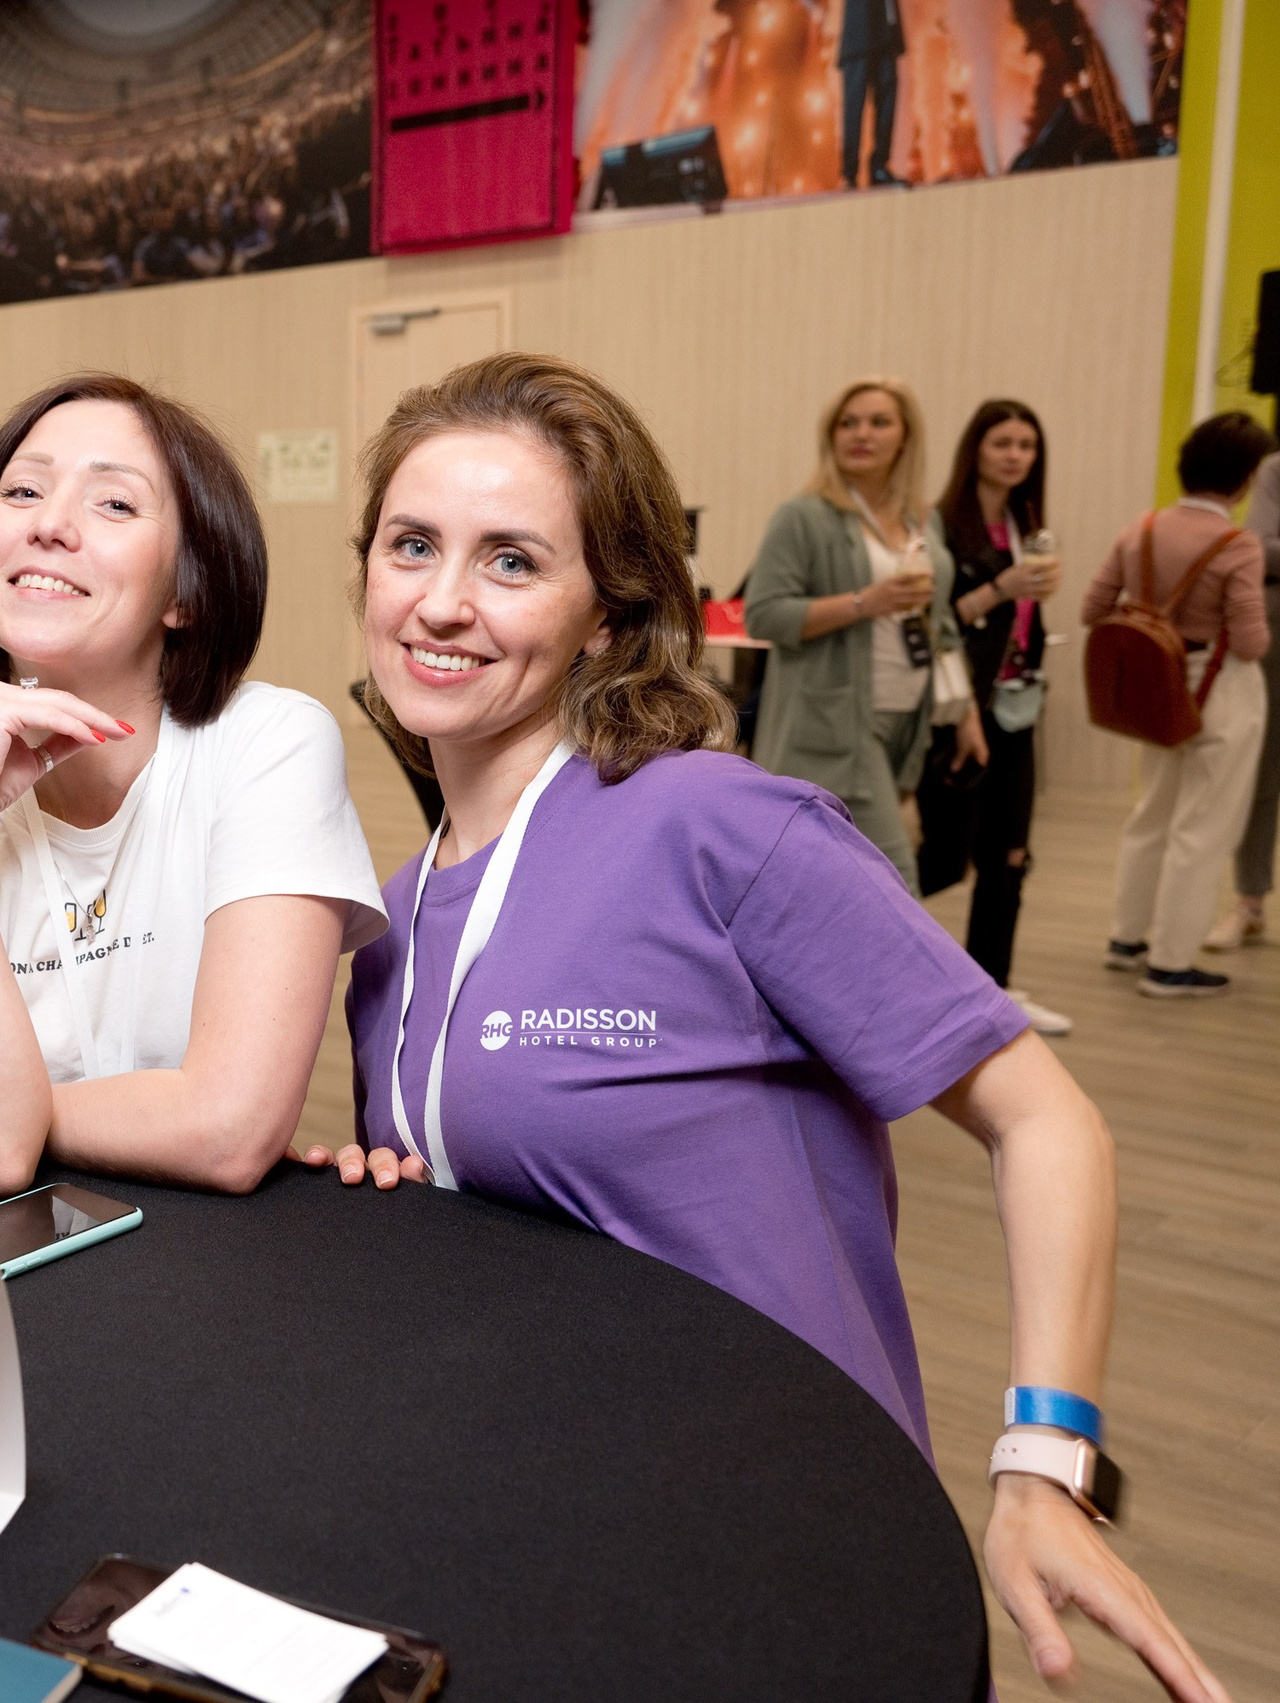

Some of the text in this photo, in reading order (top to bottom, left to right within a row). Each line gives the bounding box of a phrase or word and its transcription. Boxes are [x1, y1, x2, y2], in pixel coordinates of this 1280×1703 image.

[520, 1008, 657, 1031] RADISSON
[519, 1035, 657, 1048] HOTEL GROUP
